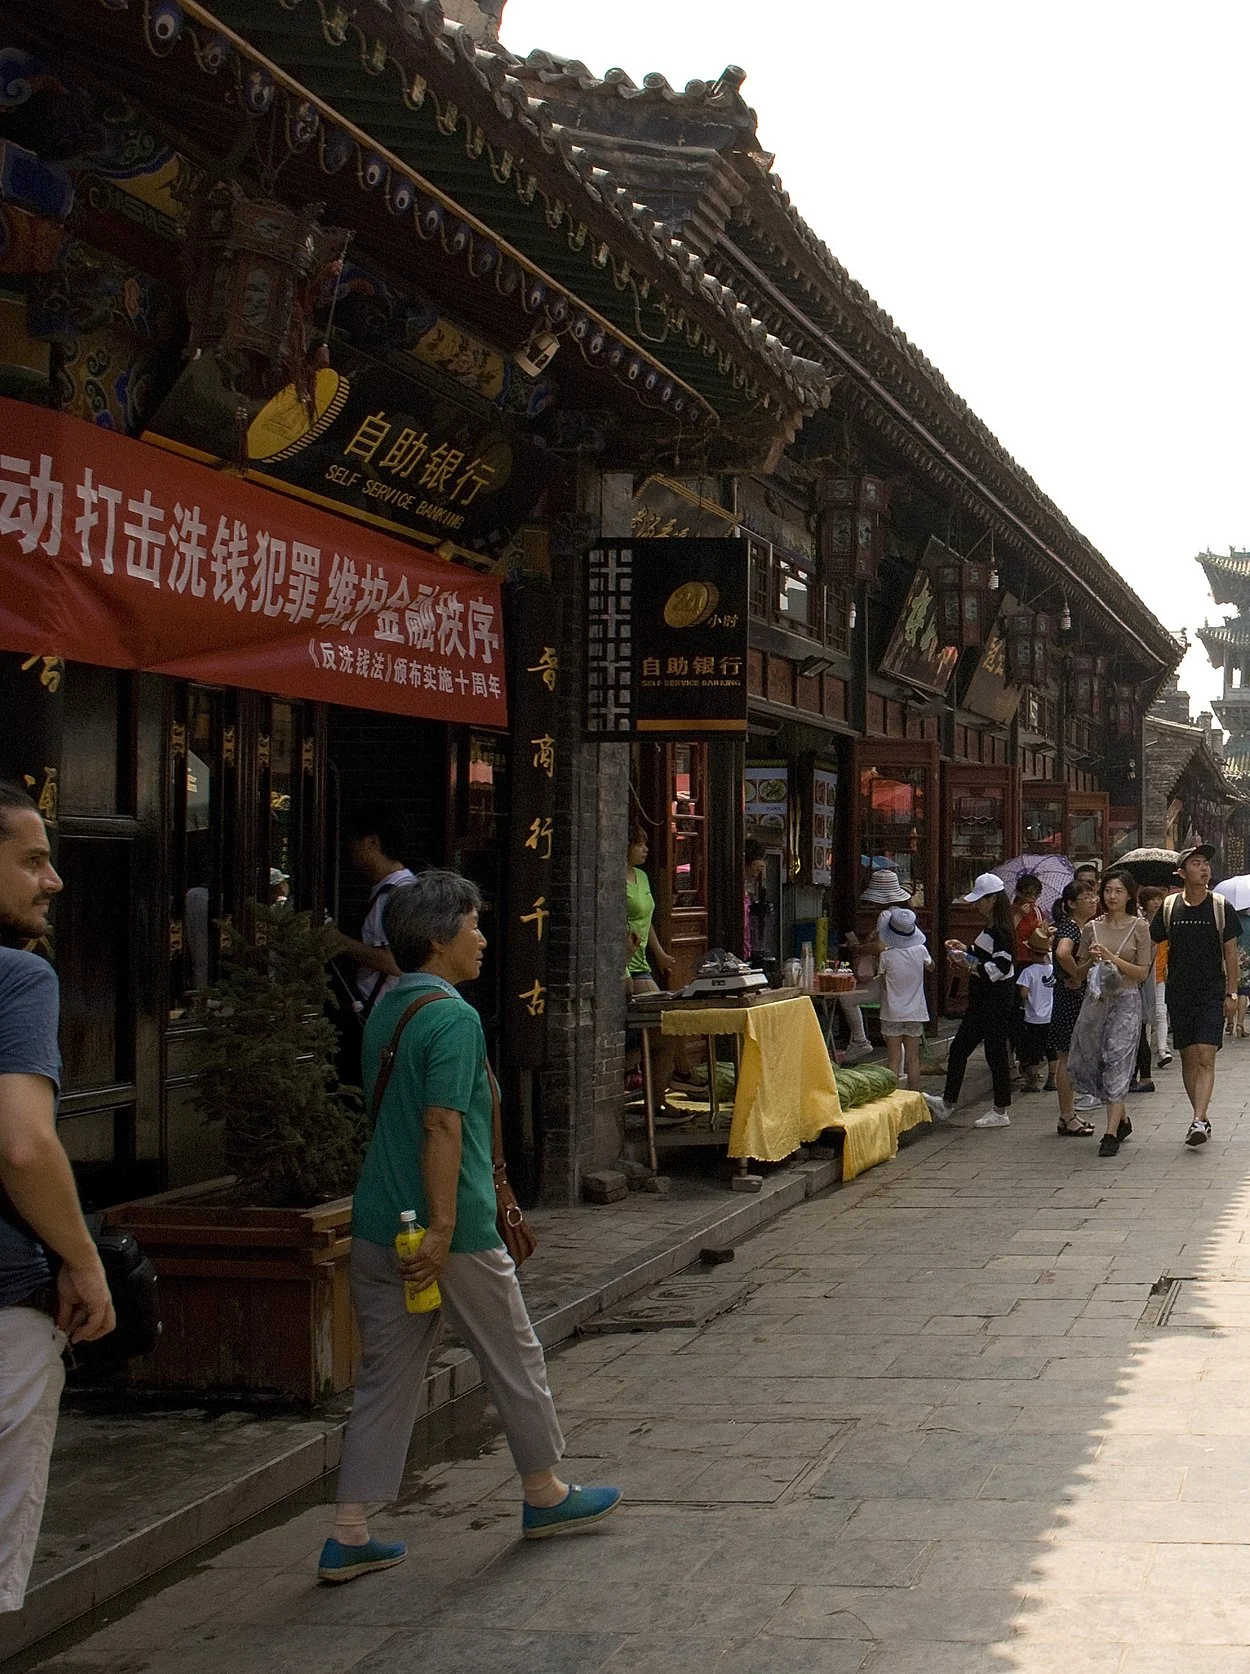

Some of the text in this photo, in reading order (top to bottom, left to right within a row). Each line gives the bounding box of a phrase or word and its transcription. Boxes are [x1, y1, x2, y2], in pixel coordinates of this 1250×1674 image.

[343, 411, 496, 506] 自助银行
[325, 464, 466, 531] SELF SERVICE BANKING
[708, 614, 739, 628] 小时
[308, 639, 502, 700] 《反洗钱法》颁布实施十周年
[641, 679, 741, 688] SELF SERVICE BANKING
[643, 656, 743, 676] 自助银行
